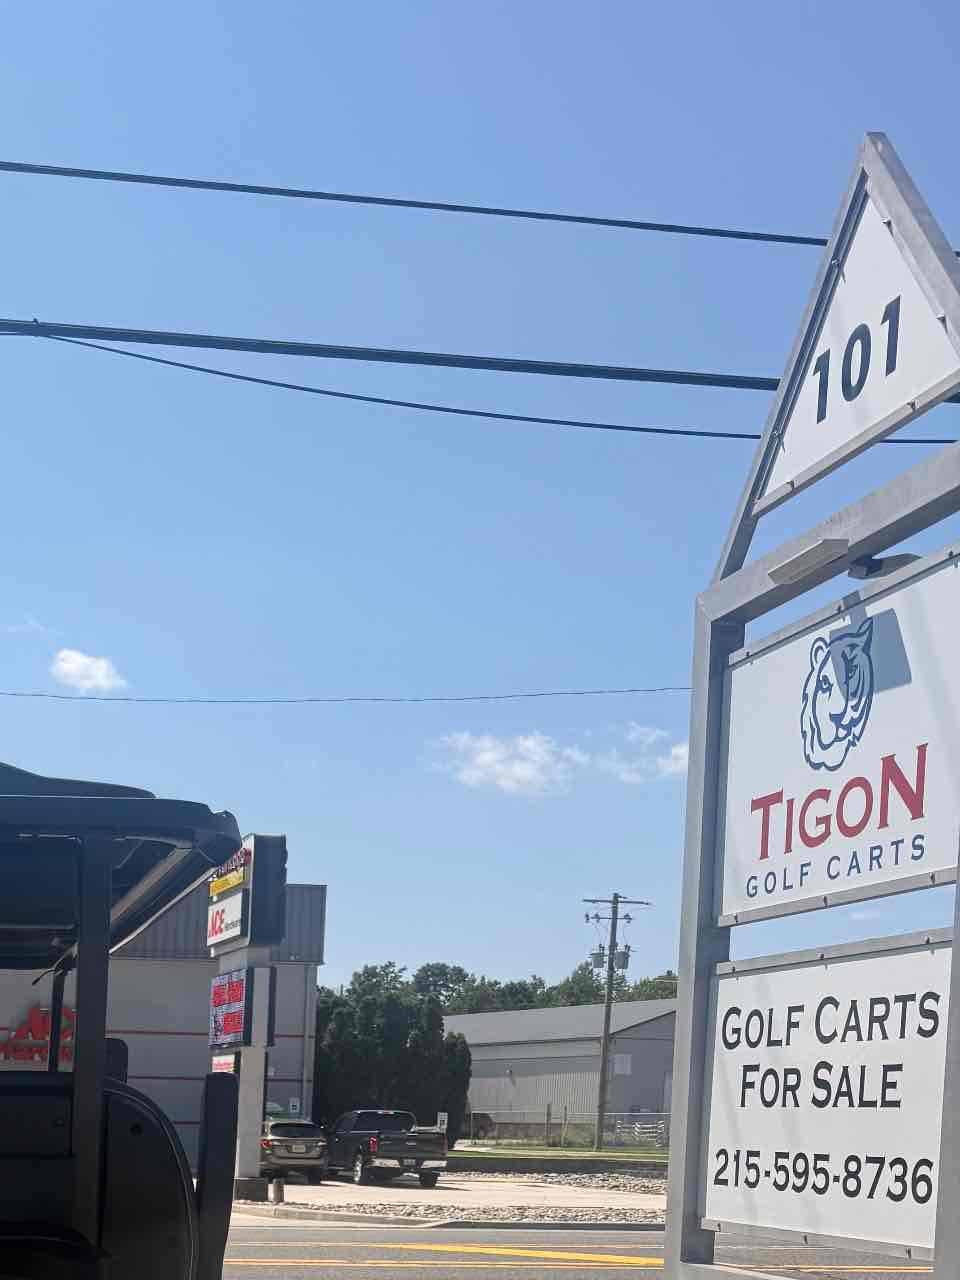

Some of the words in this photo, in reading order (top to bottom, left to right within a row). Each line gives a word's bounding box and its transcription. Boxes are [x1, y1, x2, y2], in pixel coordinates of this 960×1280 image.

[813, 295, 901, 424] 101
[751, 743, 929, 860] TIGON
[746, 862, 812, 898] GOLF
[826, 834, 925, 880] CARTS
[714, 1148, 934, 1204] 215-595-8736
